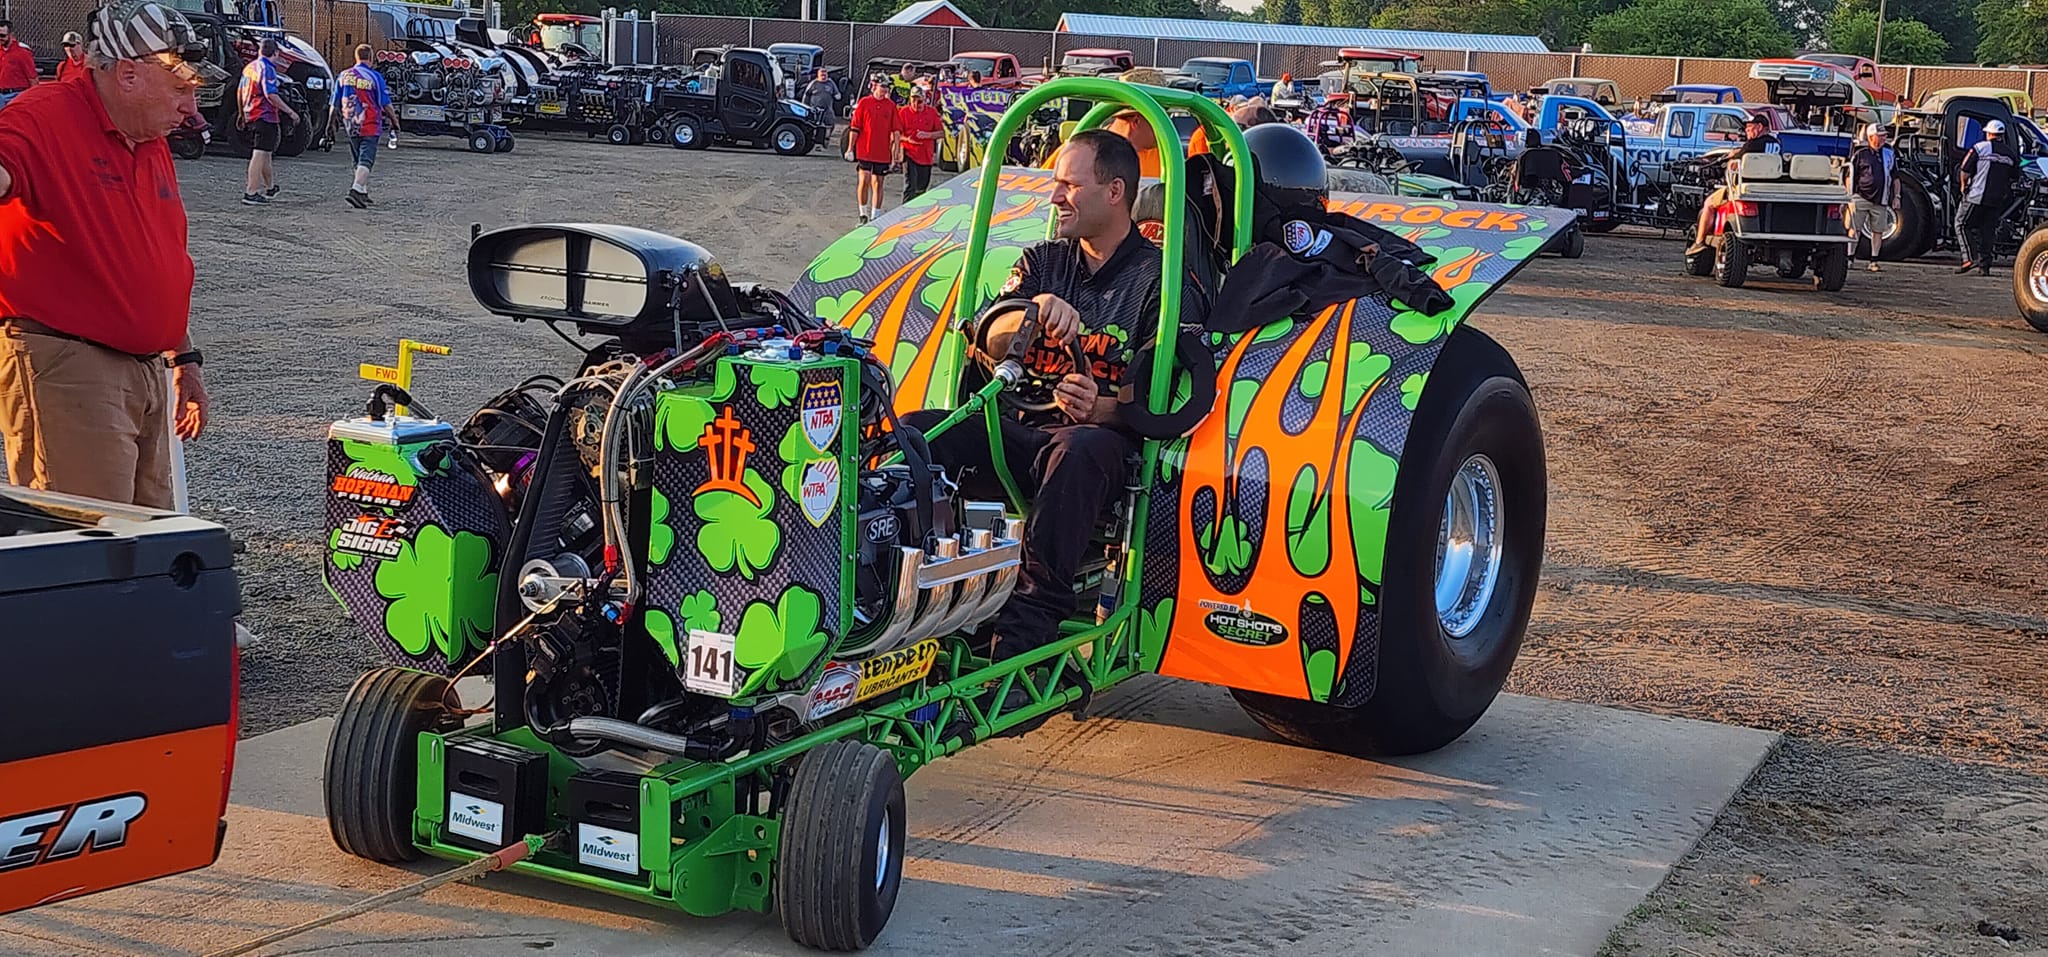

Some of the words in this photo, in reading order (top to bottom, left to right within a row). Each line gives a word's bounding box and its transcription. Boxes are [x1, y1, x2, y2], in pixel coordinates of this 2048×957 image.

[375, 367, 399, 381] FWD
[810, 409, 834, 430] NTPA
[348, 468, 397, 485] Nathan
[333, 476, 414, 502] HOFFMAN
[337, 491, 401, 507] FARMS
[803, 482, 826, 498] WTPA
[869, 516, 894, 540] SRE
[337, 532, 402, 556] SIGNS
[1210, 614, 1236, 626] HOT
[1217, 624, 1274, 642] SECRET
[691, 645, 732, 684] 141
[857, 667, 921, 698] LUBRICANTS
[452, 811, 496, 833] Midwest
[582, 842, 631, 863] Midwest
